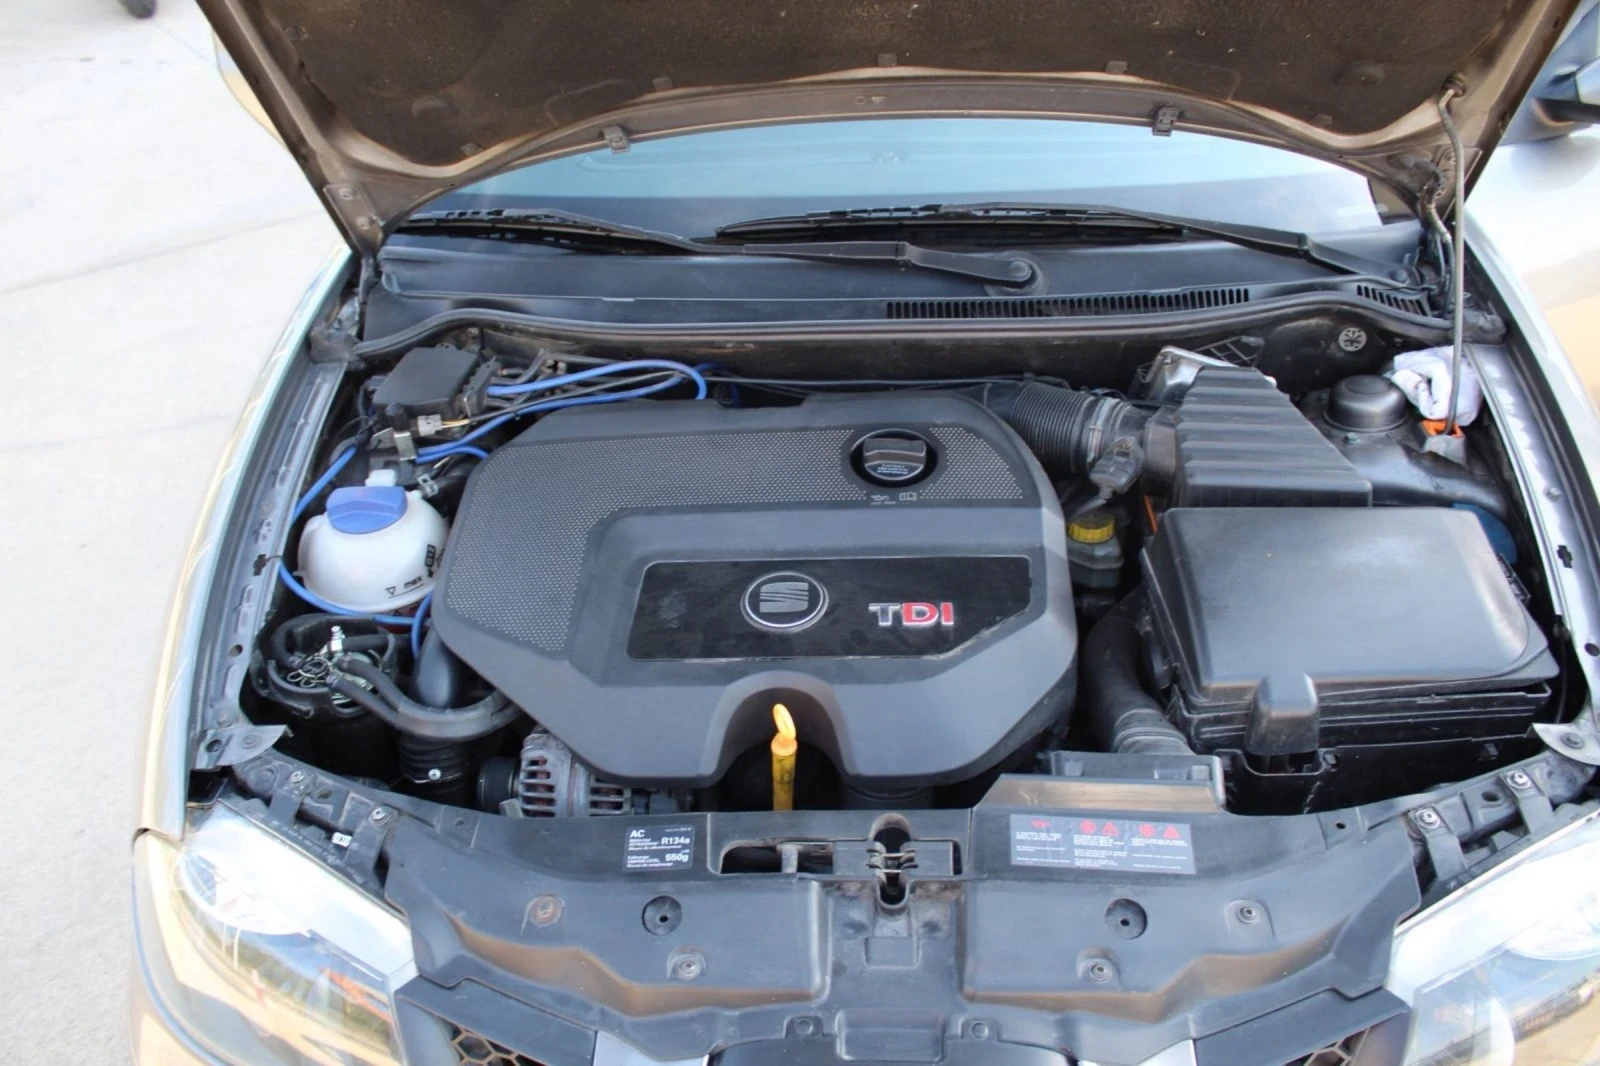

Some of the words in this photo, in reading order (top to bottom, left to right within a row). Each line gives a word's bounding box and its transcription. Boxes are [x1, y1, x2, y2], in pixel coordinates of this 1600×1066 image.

[868, 602, 954, 626] TDI
[629, 829, 646, 838] AC
[661, 836, 691, 845] R134a
[665, 853, 689, 863] 550g
